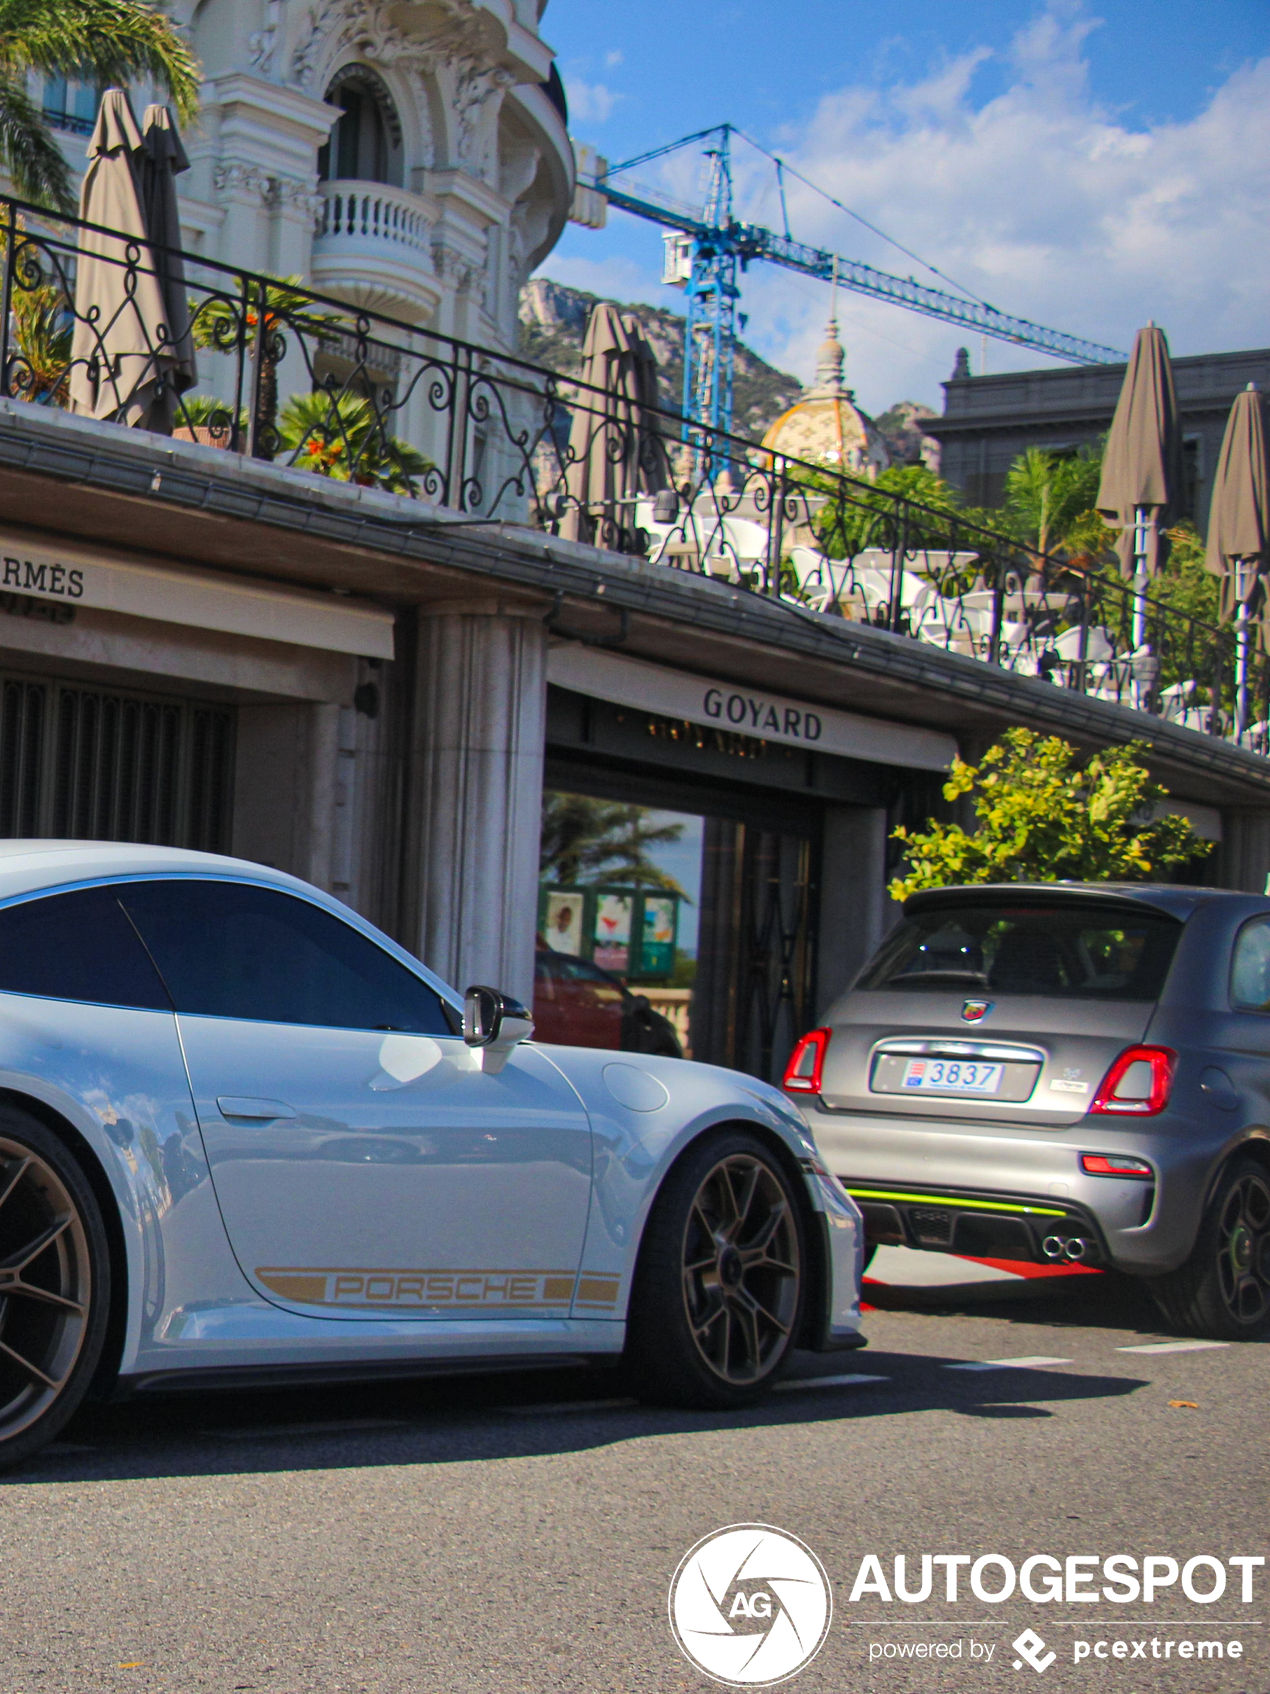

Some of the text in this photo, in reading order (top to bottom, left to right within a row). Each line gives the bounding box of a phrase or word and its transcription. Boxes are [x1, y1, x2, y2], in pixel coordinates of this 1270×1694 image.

[703, 688, 822, 741] GOYARD
[929, 1062, 996, 1086] 3837
[334, 1277, 538, 1300] PORSCHE
